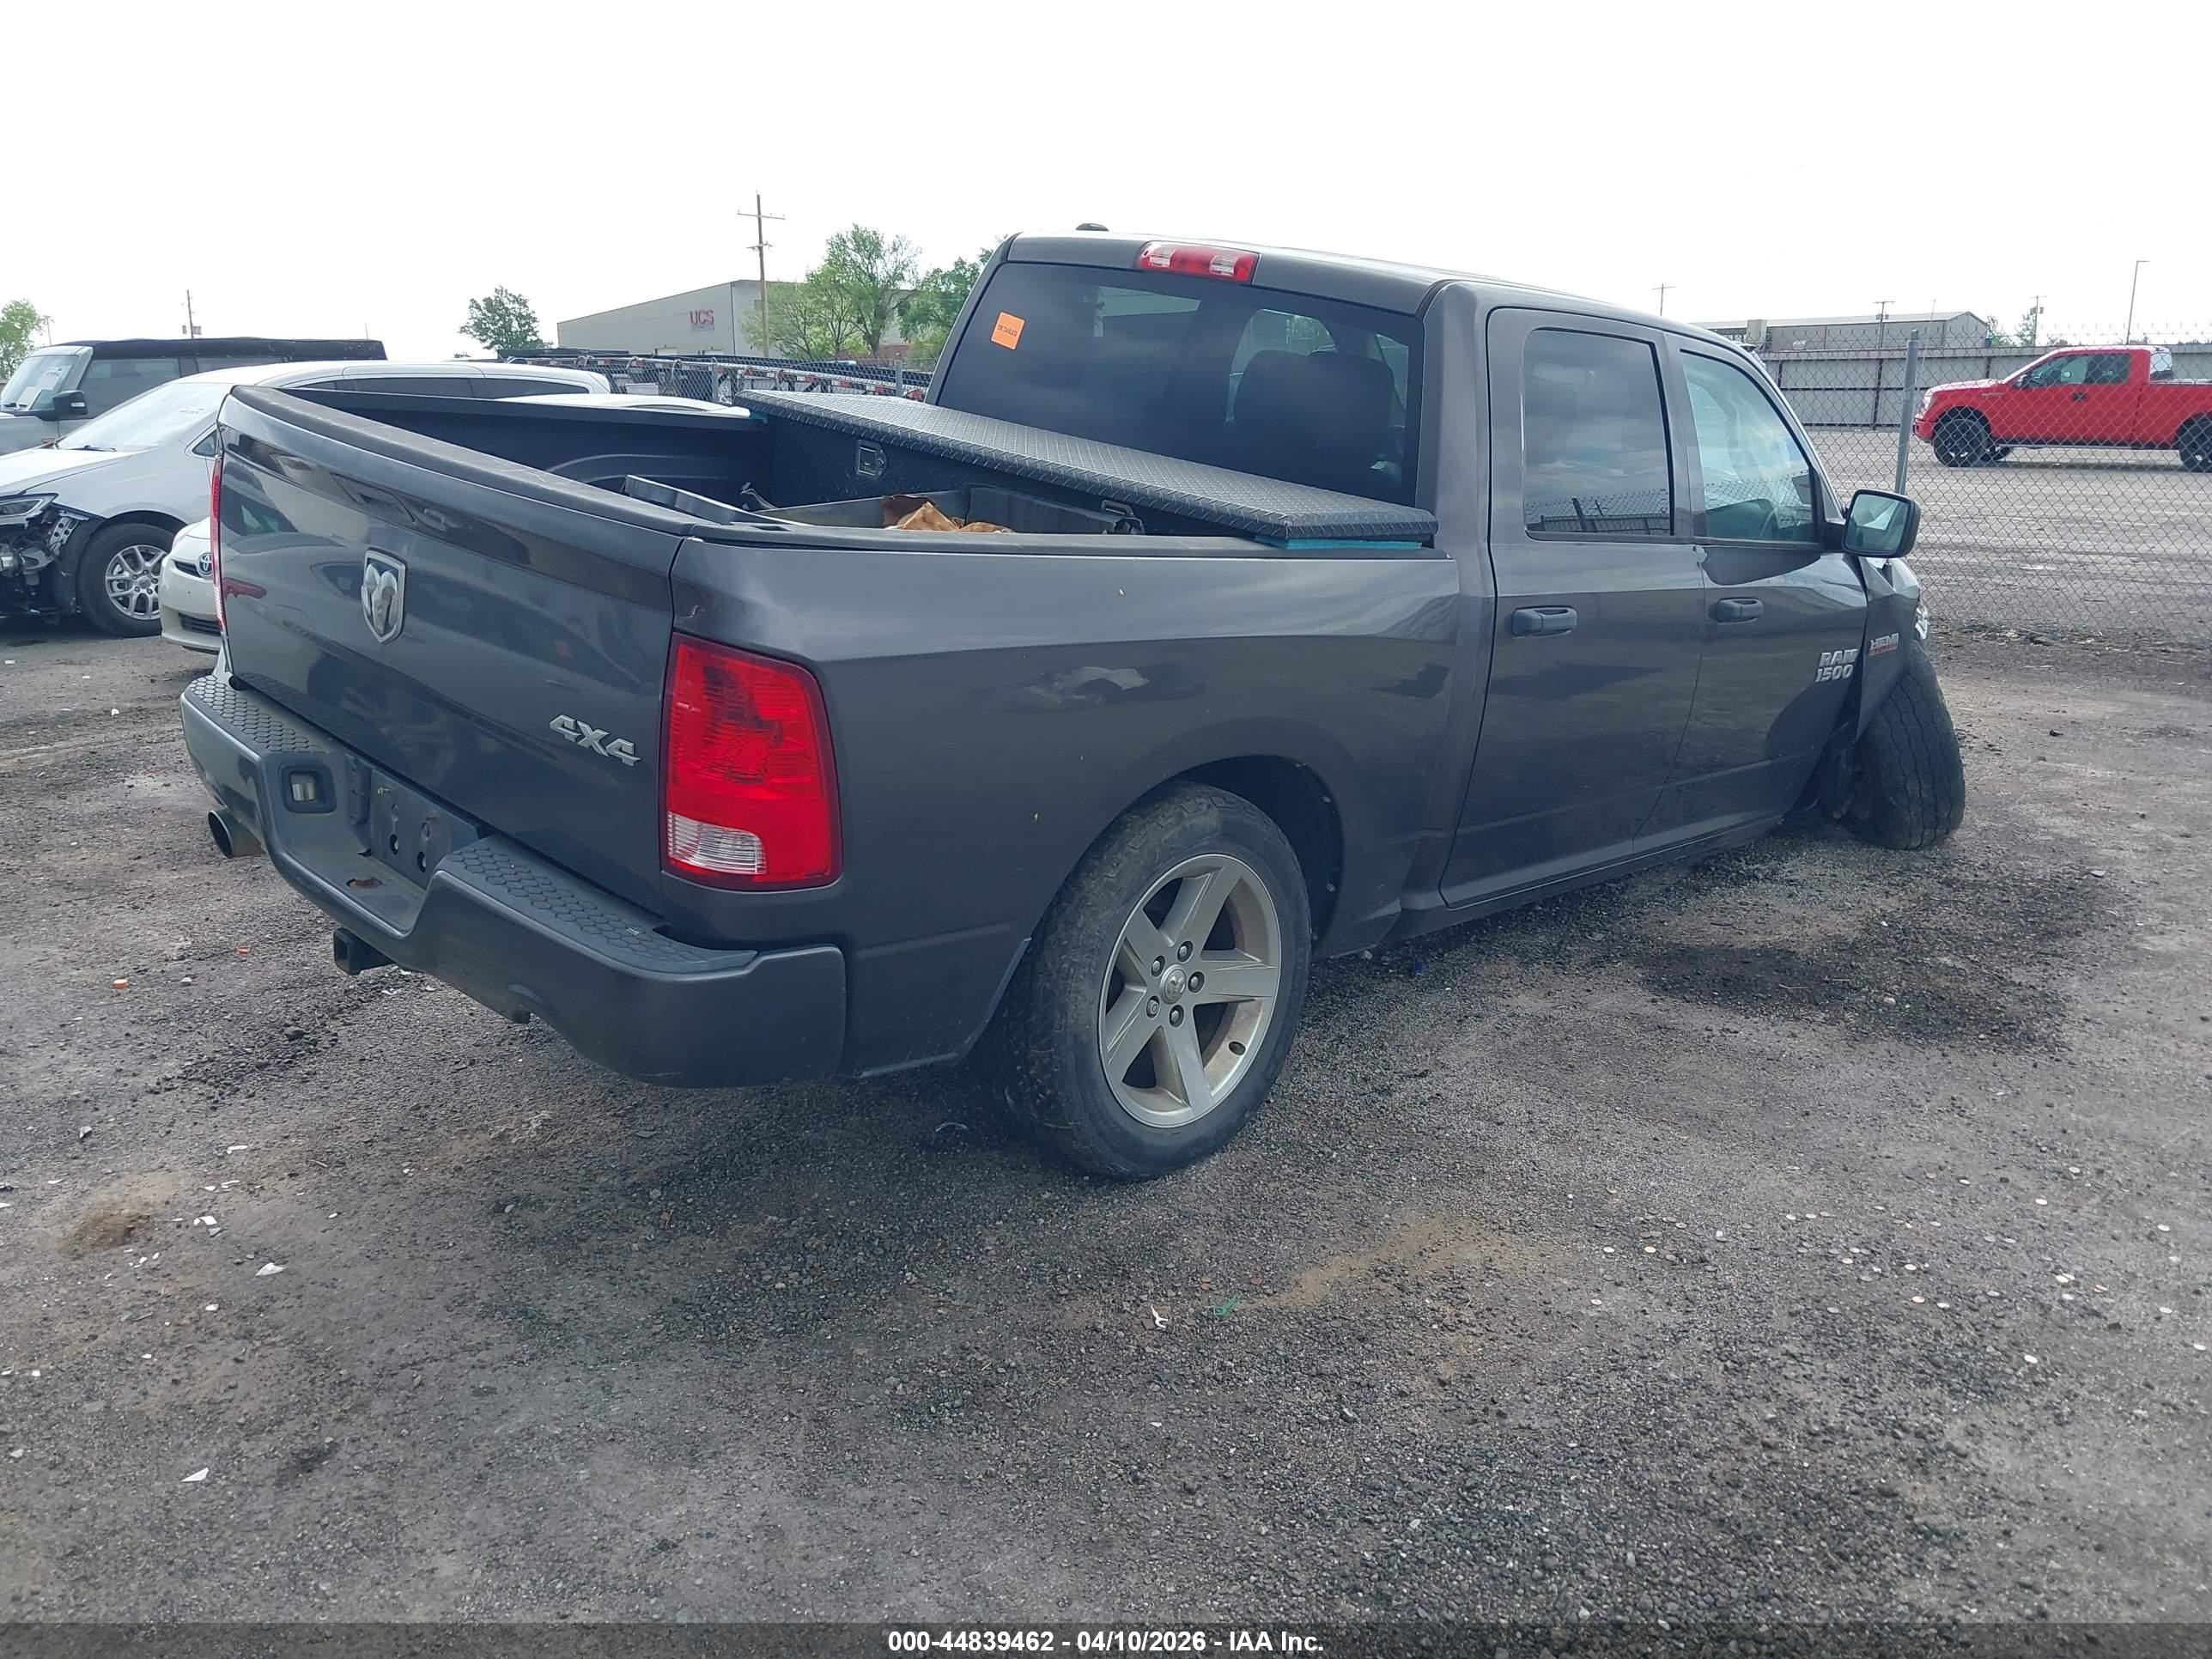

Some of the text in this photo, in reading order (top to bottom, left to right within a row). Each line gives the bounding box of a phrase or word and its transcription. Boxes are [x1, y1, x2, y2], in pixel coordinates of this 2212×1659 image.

[690, 309, 714, 325] UCS
[1819, 648, 1858, 667] RAM
[1815, 664, 1854, 683] 1500
